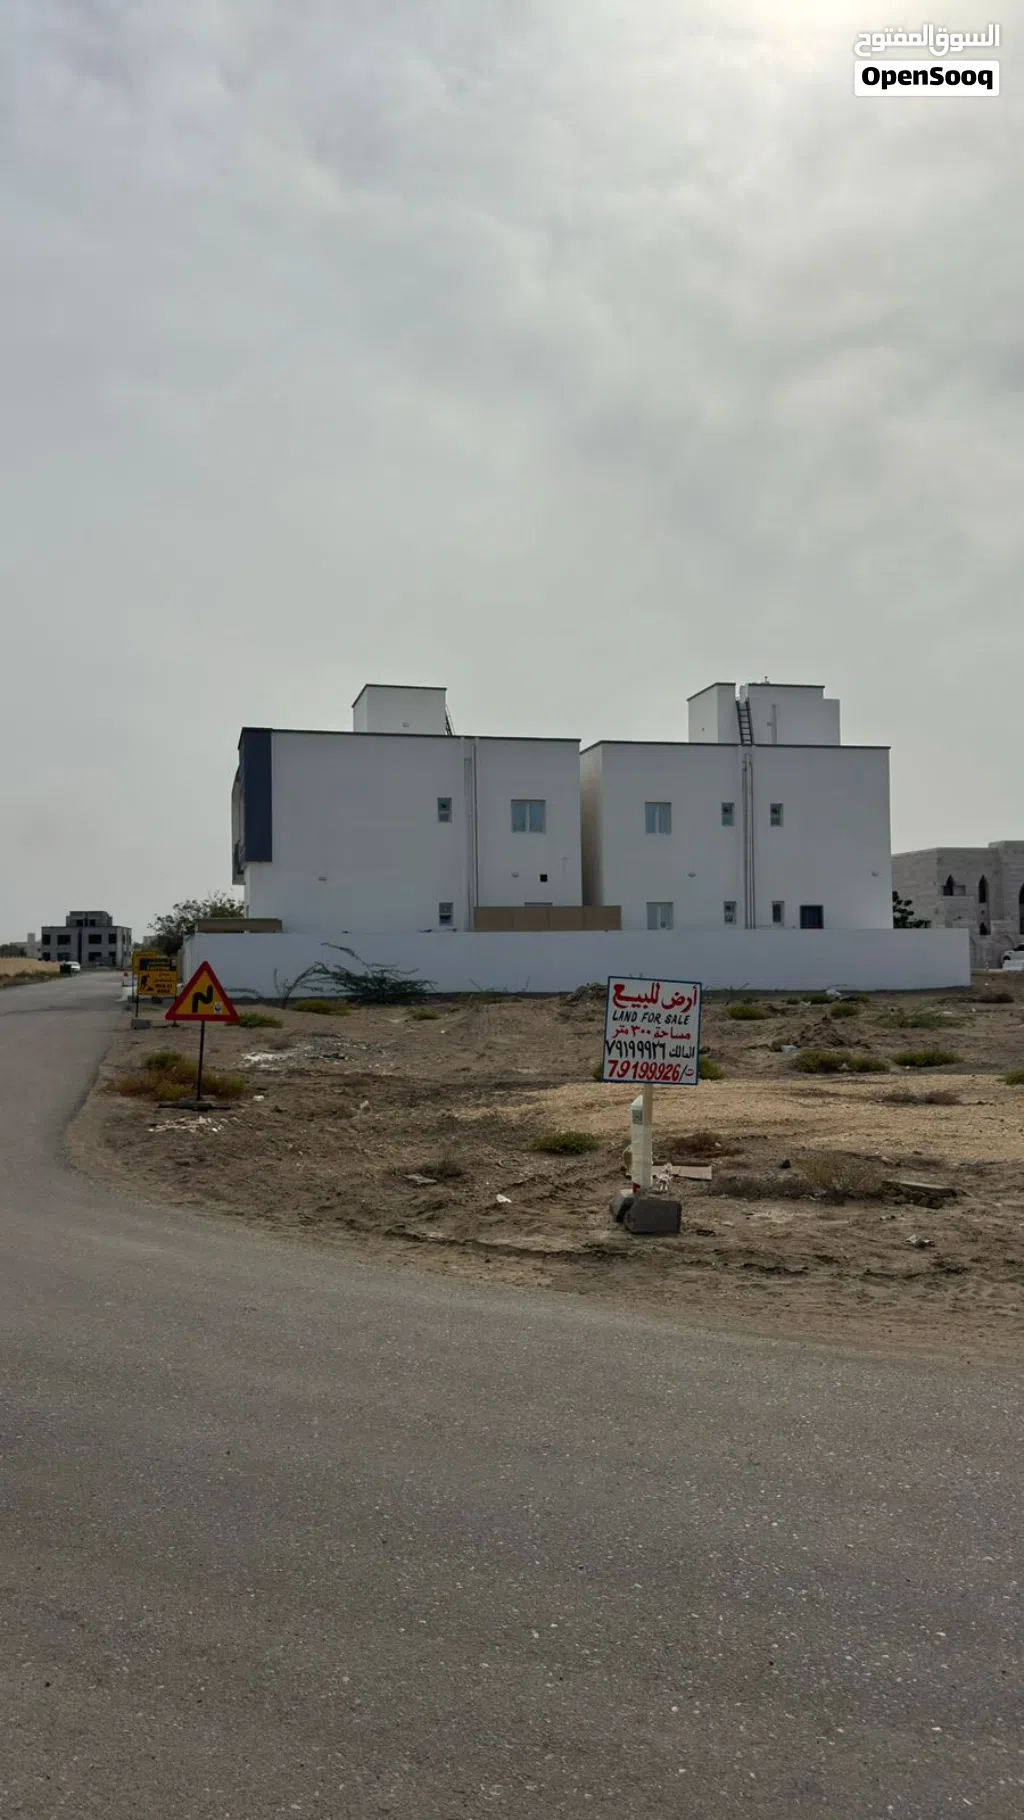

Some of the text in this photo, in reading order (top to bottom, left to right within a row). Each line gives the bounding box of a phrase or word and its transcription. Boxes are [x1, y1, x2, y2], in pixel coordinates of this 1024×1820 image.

[613, 983, 697, 1013] أرض للبيع
[612, 1011, 690, 1025] LAND FOR SALE
[613, 1025, 629, 1038] متر
[654, 1027, 691, 1039] مساحة
